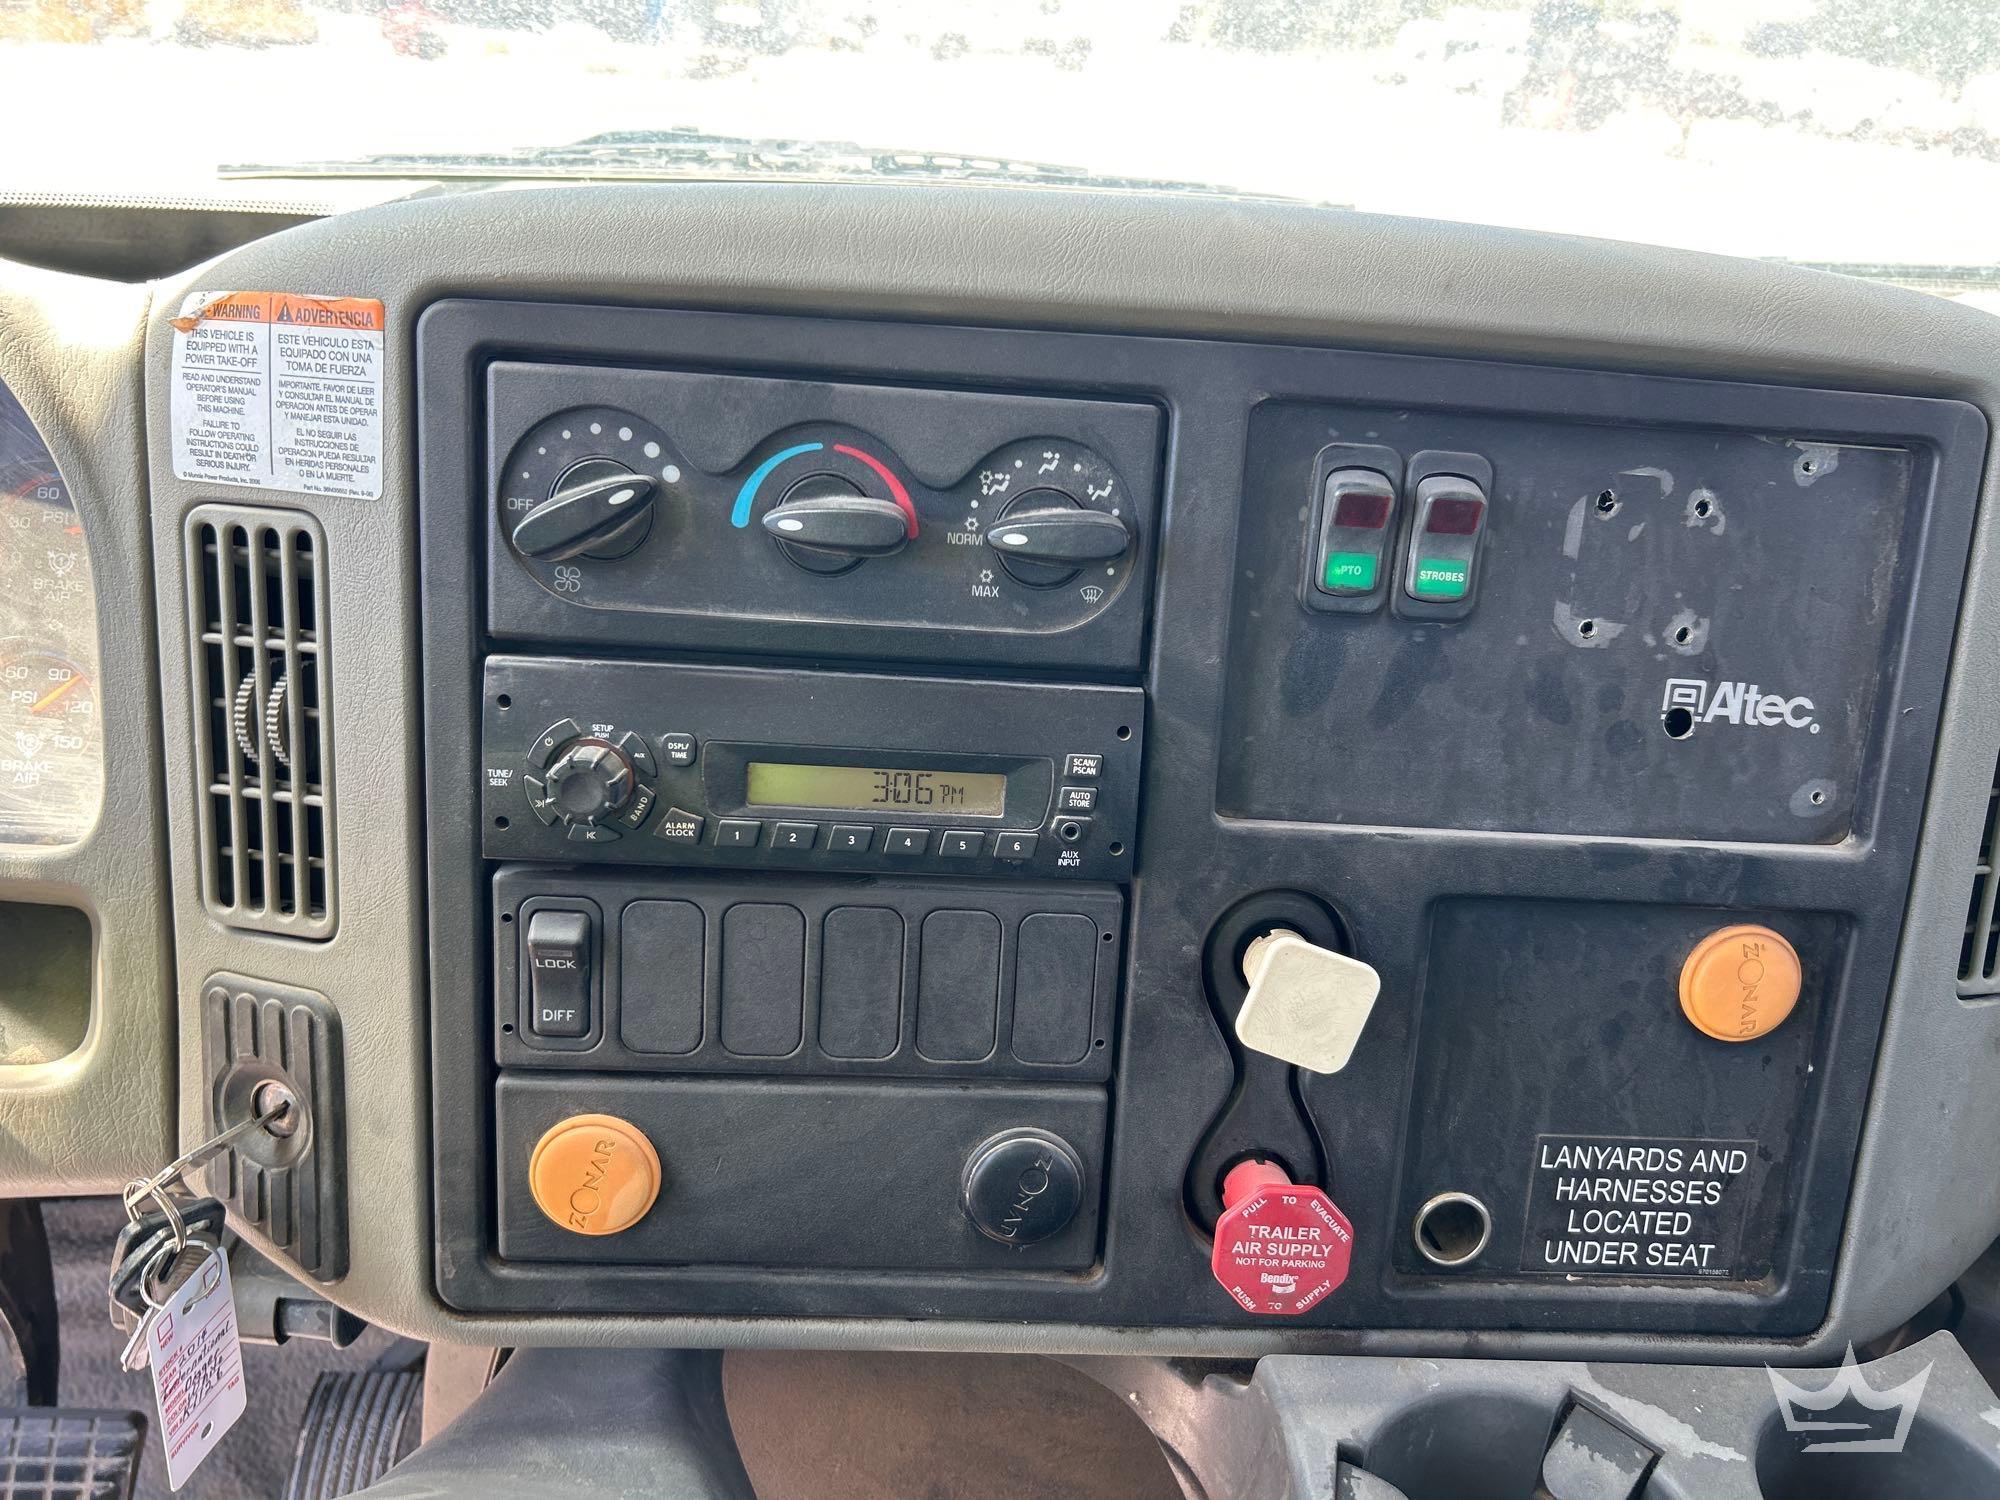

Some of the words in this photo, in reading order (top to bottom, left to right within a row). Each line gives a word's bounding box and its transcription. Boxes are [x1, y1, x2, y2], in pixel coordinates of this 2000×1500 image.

[213, 303, 260, 319] WARNING
[296, 308, 374, 326] ADVERTENCIA
[191, 329, 208, 338] THIS
[210, 330, 244, 341] VEHICLE
[246, 332, 254, 341] IS
[187, 341, 226, 352] EQUIPPED
[228, 343, 249, 354] WITH
[252, 345, 258, 354] A
[278, 334, 300, 345] ESTE
[302, 336, 348, 348] VEHICULO
[352, 339, 375, 350] ESTA
[185, 354, 215, 365] POWER
[217, 356, 257, 368] TAKE-OFF
[280, 347, 326, 360] EQUIPADO
[329, 350, 349, 361] CON
[352, 352, 373, 363] UNA
[286, 361, 313, 372] TOMA
[315, 363, 327, 373] DE
[330, 364, 366, 376] FUERZA
[183, 373, 199, 381] READ
[201, 374, 214, 382] AND
[216, 375, 261, 386] UNDERSTAND
[186, 383, 227, 393] OPERATOR'S
[228, 386, 256, 396] MANUAL
[324, 384, 345, 393] FAVOR
[347, 385, 356, 394] DE
[358, 386, 375, 395] LEER
[197, 394, 223, 403] BEFORE
[224, 396, 245, 405] USING
[279, 390, 283, 398] Y
[285, 391, 323, 402] CONSULTAR
[326, 394, 333, 402] EL
[335, 395, 363, 405] MANUAL
[365, 397, 375, 406] DE
[276, 401, 314, 411] OPERACION
[316, 404, 338, 413] ANTES
[339, 406, 349, 414] DE
[350, 407, 378, 417] OPERAR
[203, 420, 229, 429] FAILURE
[231, 422, 240, 430] TO
[290, 412, 322, 422] MANEJAR
[324, 415, 340, 424] ESTA
[342, 417, 369, 426] UNIDAD.
[190, 428, 215, 438] FOLLOW
[217, 431, 255, 442] OPERATING
[297, 428, 303, 436] EL
[306, 429, 316, 437] NO
[318, 430, 342, 440] SEGUIR
[344, 433, 357, 441] LAS
[186, 438, 234, 450] INSTRUCTIONS
[235, 443, 259, 452] COULD
[295, 438, 348, 451] INSTRUCCIONES
[350, 444, 359, 452] DE
[190, 448, 214, 458] RESULT
[224, 452, 244, 461] DEATH
[246, 454, 256, 462] OR
[278, 447, 317, 458] OPERACION
[318, 451, 341, 460] PUEDA
[342, 453, 376, 464] RESULTAR
[196, 459, 224, 469] SERIOUS
[226, 462, 250, 471] INJURY.
[285, 457, 294, 465] EN
[296, 459, 324, 469] HERIDAS
[326, 462, 369, 473] PERSONALES
[37, 487, 60, 500] 60
[507, 498, 534, 511] OFF
[947, 532, 983, 545] NORM
[1341, 565, 1362, 576] PTO
[1420, 570, 1464, 583] STROBES
[33, 579, 83, 592] BRAKE
[972, 585, 999, 598] MAX
[5, 667, 28, 679] 60
[48, 668, 71, 681] 90
[11, 690, 38, 703] PSI
[592, 724, 614, 732] SETUP
[1, 760, 53, 772] BRAKE
[1073, 758, 1097, 768] SCAN/
[488, 769, 513, 778] TUNE/
[1073, 766, 1096, 775] PSCAN
[13, 772, 40, 784] AIR
[490, 778, 508, 786] SEEK
[940, 784, 964, 805] PM
[1070, 791, 1090, 800] AUTO
[630, 796, 648, 822] BAND
[1069, 799, 1089, 808] STORE
[666, 822, 695, 830] ALARM
[666, 829, 694, 837] CLOCK
[734, 831, 740, 840] 1
[789, 833, 797, 842] 2
[848, 836, 855, 845] 3
[904, 838, 911, 846] 4
[959, 841, 966, 850] 5
[1013, 841, 1020, 850] 6
[1061, 851, 1079, 859] AUX
[1058, 858, 1081, 867] INPUT
[536, 959, 576, 969] LOCK
[1738, 943, 1764, 1034] ZONAR
[542, 1009, 575, 1021] DIFF
[1541, 1145, 1682, 1173] LANYARDS
[1690, 1149, 1747, 1174] AND
[568, 1140, 616, 1229] ZONAR
[1555, 1177, 1721, 1205] HARNESSES
[1242, 1197, 1267, 1218] PULL
[1282, 1196, 1297, 1205] TO
[1310, 1199, 1350, 1243] EVACUATE
[1567, 1209, 1692, 1236] LOCATED
[1248, 1225, 1321, 1241] TRAILER
[1232, 1241, 1261, 1255] AIR
[1267, 1243, 1333, 1257] SUPPLY
[1544, 1240, 1637, 1266] UNDER
[1645, 1242, 1715, 1268] SEAT
[1235, 1257, 1257, 1266] NOT
[1259, 1258, 1280, 1267] FOR
[1282, 1259, 1326, 1269] PARKING
[1260, 1272, 1295, 1284] Bendix
[1232, 1286, 1256, 1310] PUSH
[1296, 1280, 1331, 1310] SUPPLY
[160, 1331, 174, 1351] NEW
[159, 1350, 178, 1376] STOCK
[162, 1366, 176, 1388] YEAR
[228, 1376, 240, 1391] TAG
[165, 1389, 184, 1414] MODEL
[167, 1398, 187, 1425] COLOR
[169, 1423, 178, 1436] VIN
[171, 1422, 199, 1459] SURVIVOR
